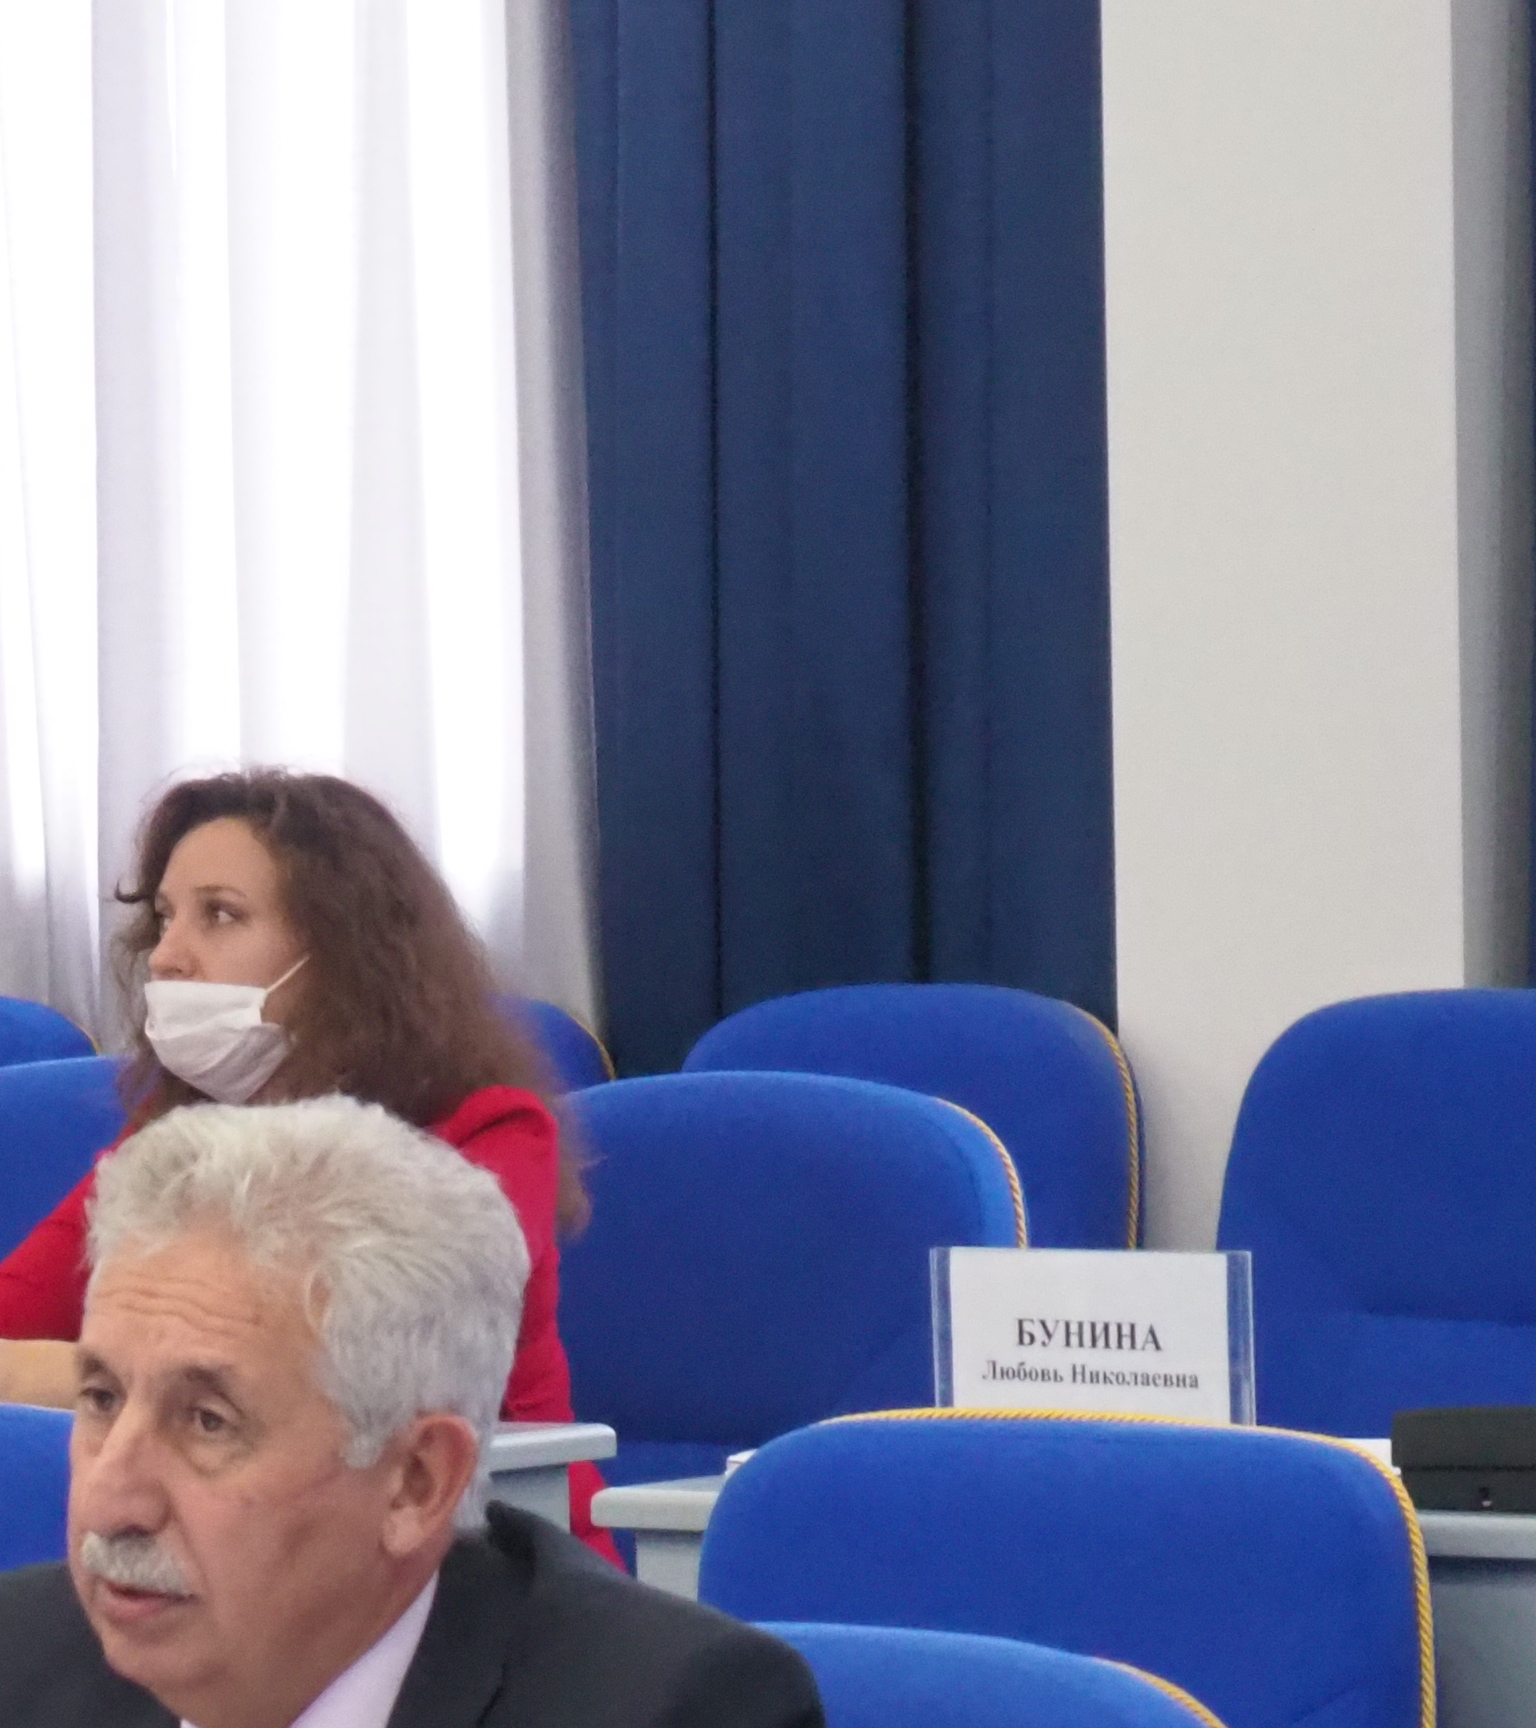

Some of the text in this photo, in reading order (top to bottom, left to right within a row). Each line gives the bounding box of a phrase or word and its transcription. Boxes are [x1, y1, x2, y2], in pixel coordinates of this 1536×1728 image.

[1016, 1318, 1162, 1351] БУНИНА
[982, 1360, 1199, 1389] Любовь Николаевна
